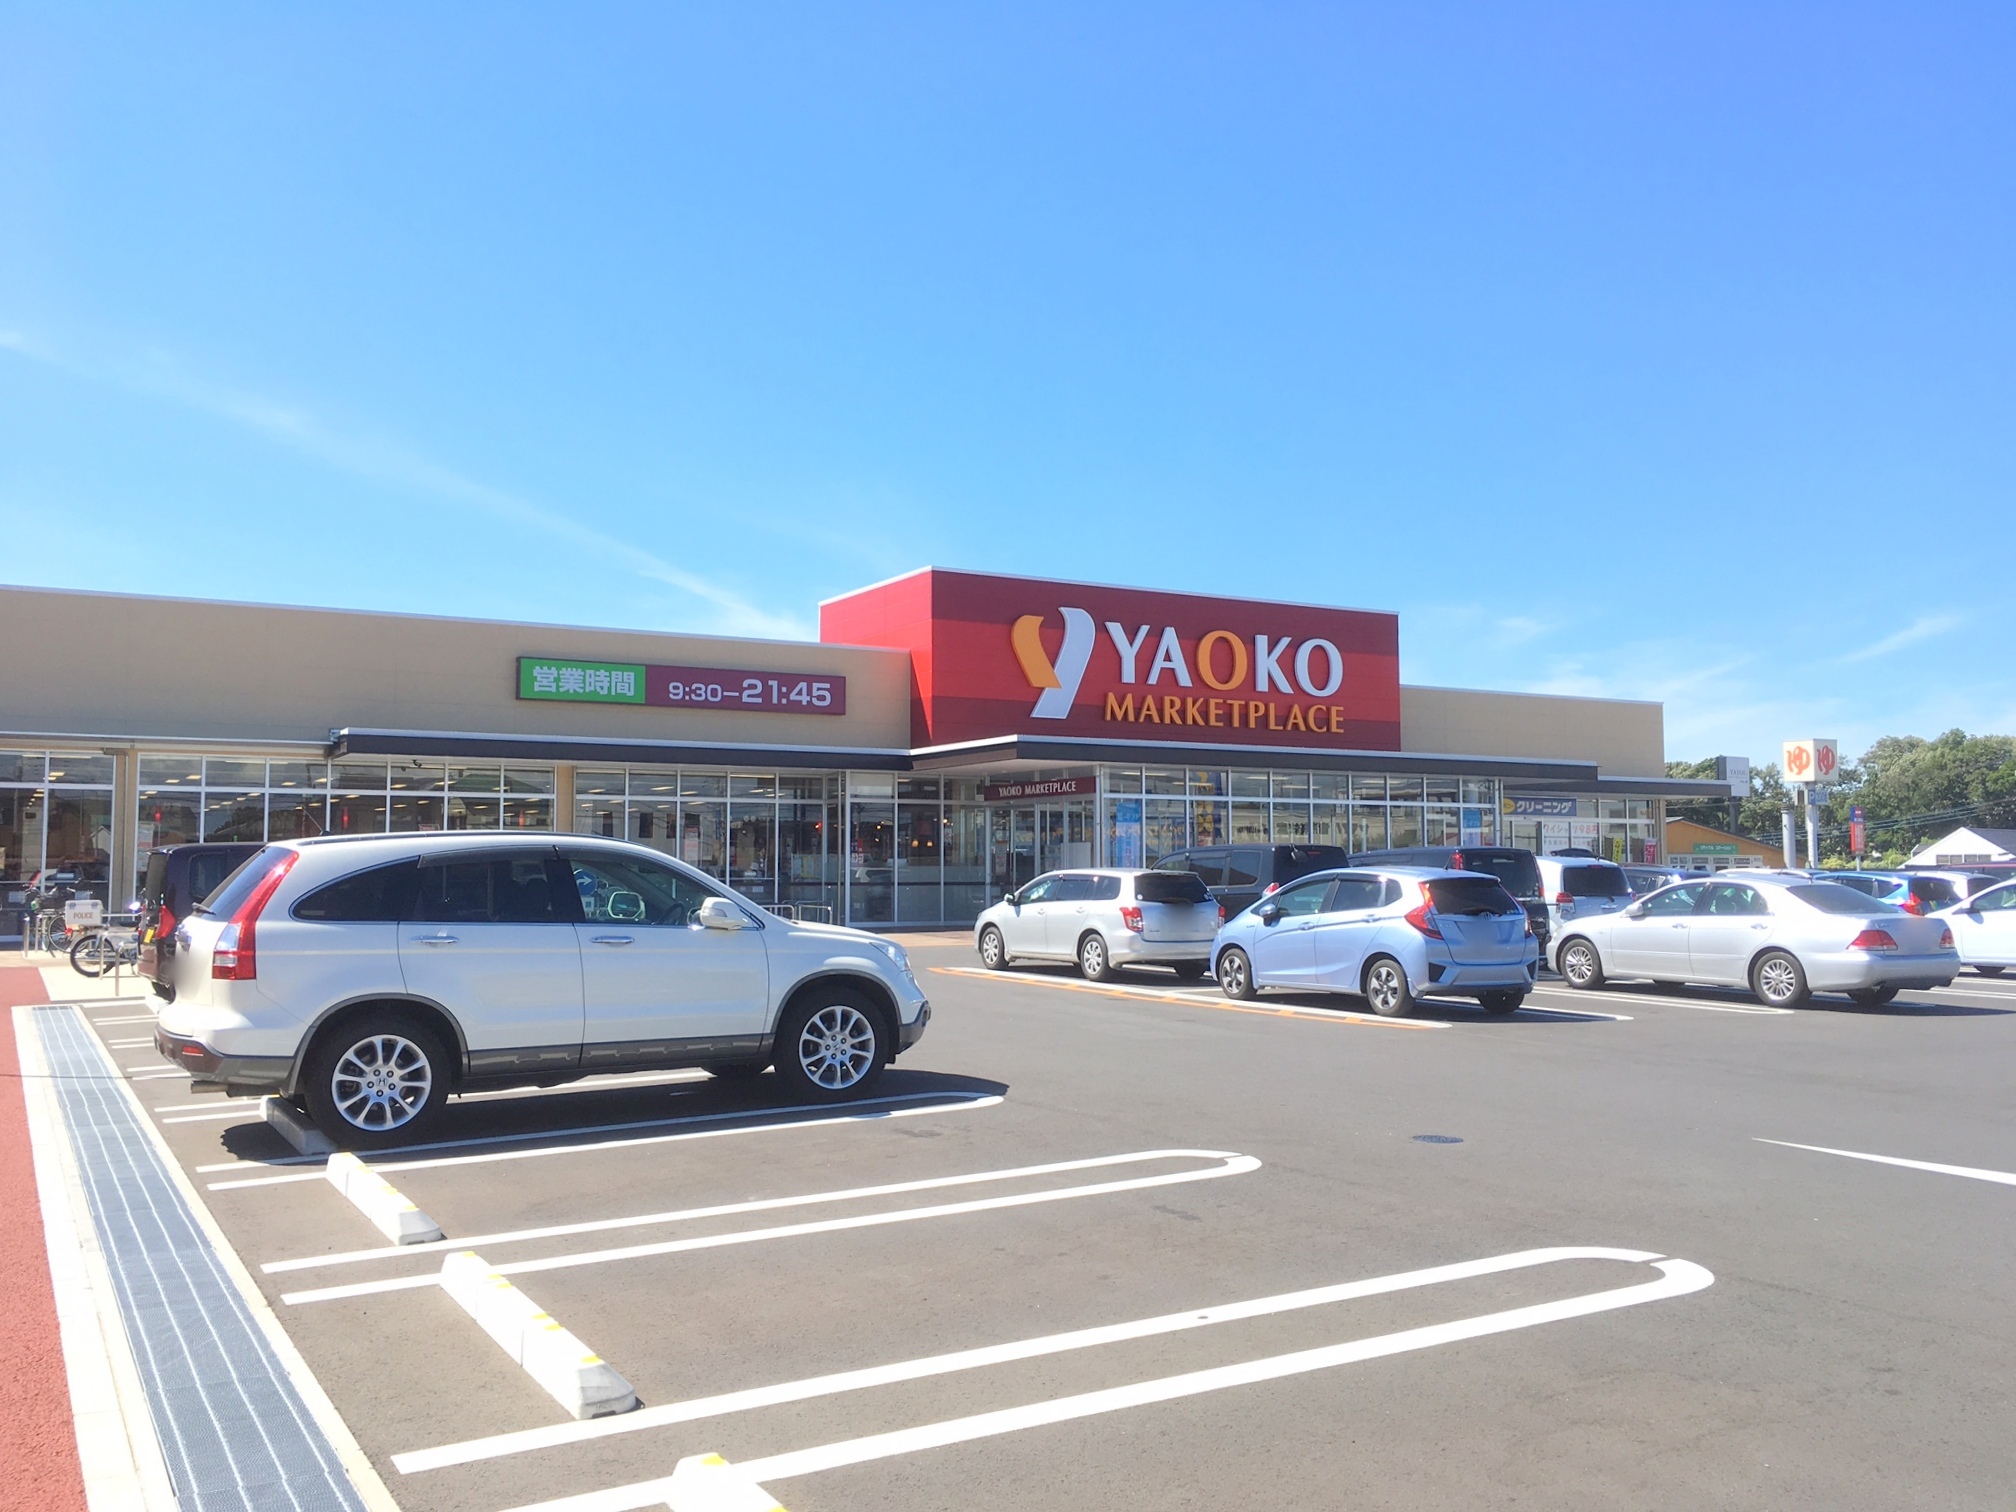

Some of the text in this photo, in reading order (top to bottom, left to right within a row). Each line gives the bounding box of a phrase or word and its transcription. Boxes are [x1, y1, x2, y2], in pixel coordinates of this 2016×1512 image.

[1104, 621, 1344, 698] YAOKO
[532, 665, 636, 697] 営業時間
[1104, 692, 1345, 734] MARKETPLACE
[998, 780, 1077, 798] YAOKO MARKETPLACE
[1516, 800, 1573, 814] クリーニング
[73, 911, 93, 919] POLICE
